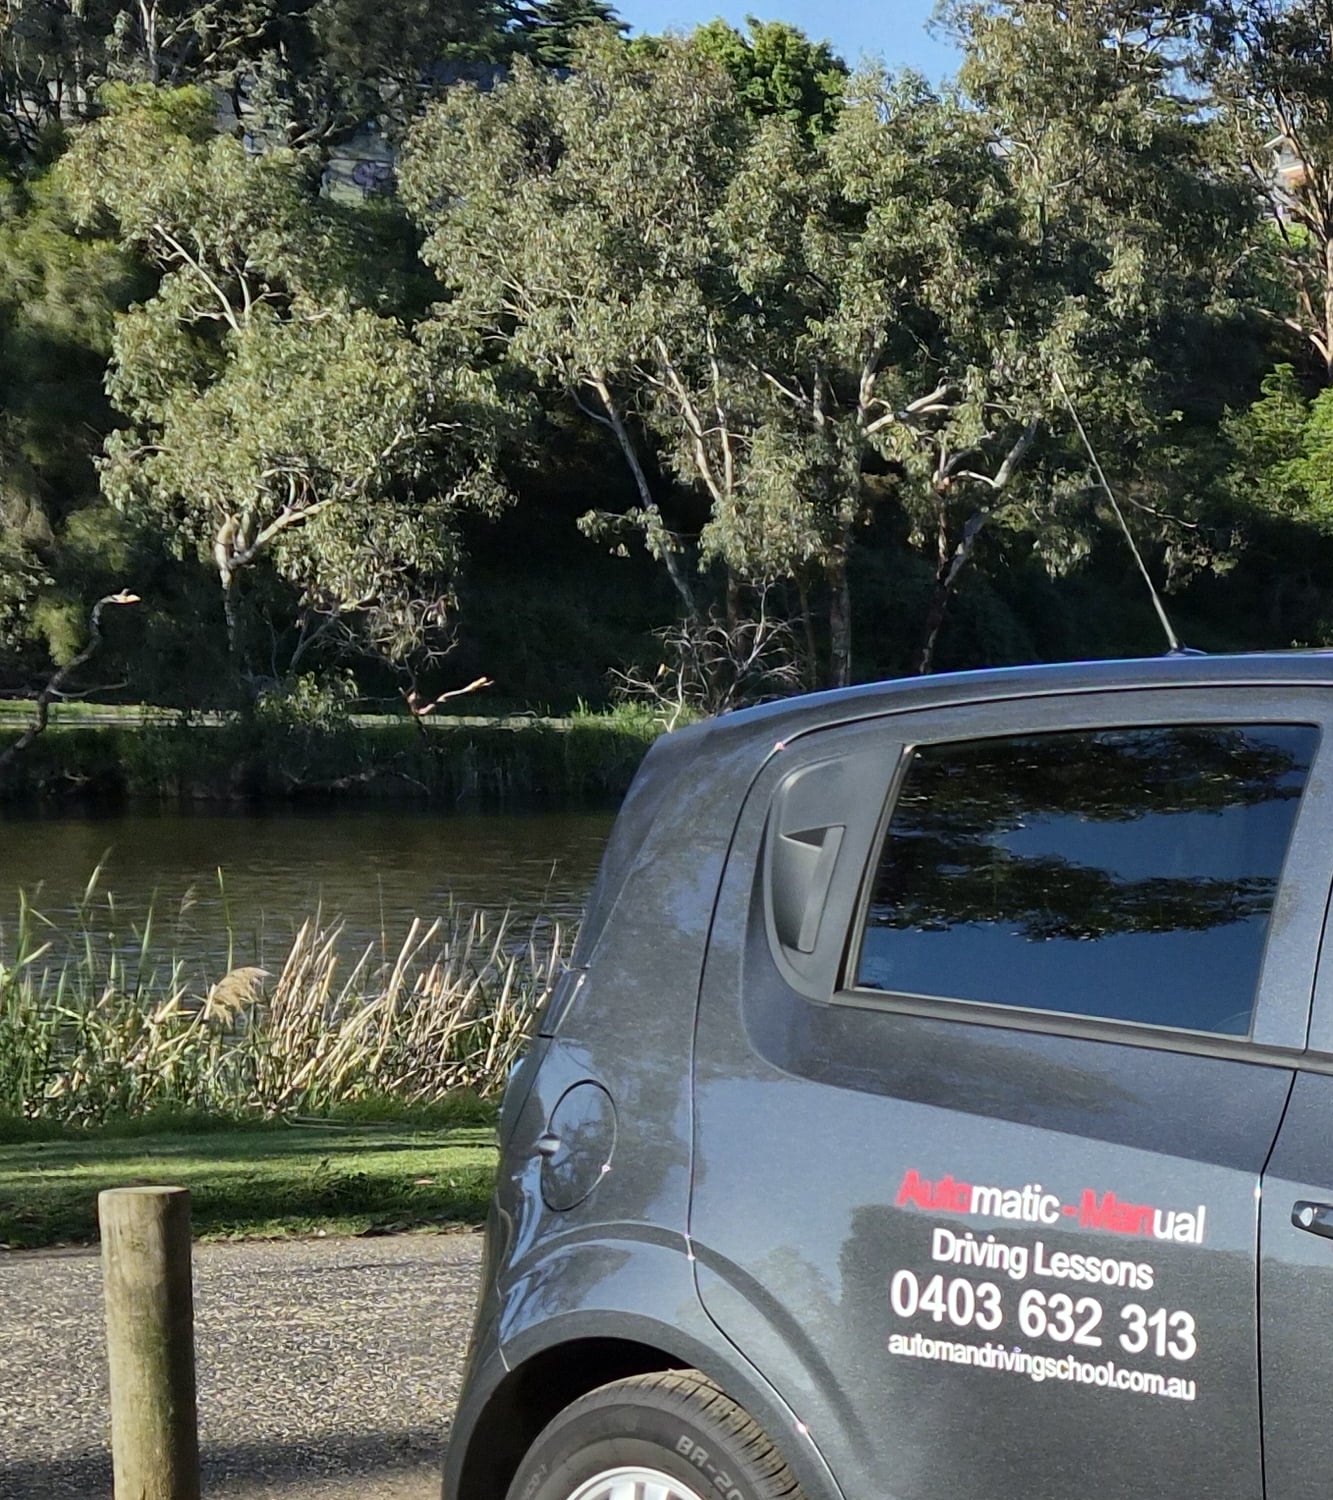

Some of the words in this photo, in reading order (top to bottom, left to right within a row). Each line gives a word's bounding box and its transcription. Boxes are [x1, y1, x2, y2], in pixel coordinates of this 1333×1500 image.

[931, 1227, 1028, 1280] Driving
[1033, 1242, 1154, 1290] Lessons
[890, 1269, 1003, 1331] 0403
[1018, 1288, 1102, 1347] 632
[1118, 1303, 1197, 1361] 313
[888, 1332, 1196, 1400] automandrivingschool.com.au
